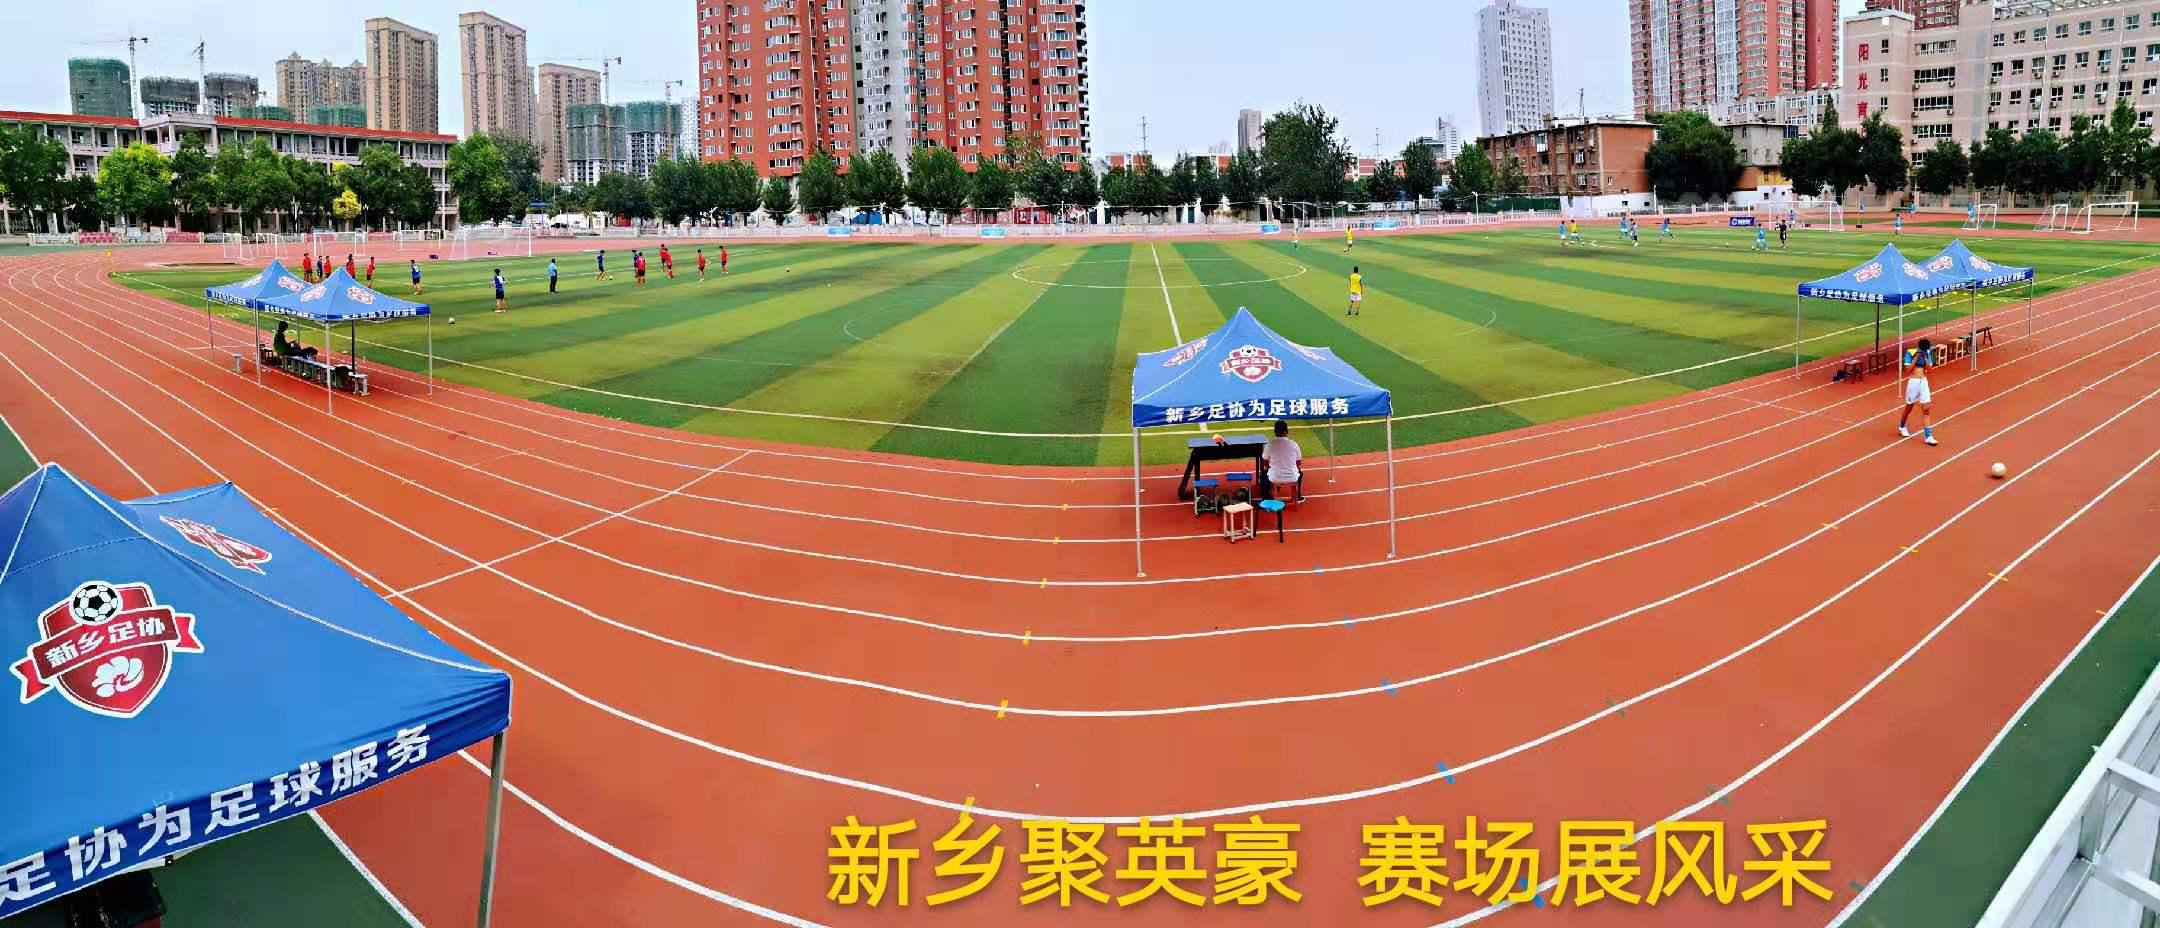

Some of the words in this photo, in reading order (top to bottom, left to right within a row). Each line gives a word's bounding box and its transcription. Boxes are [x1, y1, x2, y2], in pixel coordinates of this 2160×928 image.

[1857, 43, 1869, 137] 阳光育
[1165, 398, 1349, 423] 新乡足协为足球服务
[44, 617, 166, 668] 新乡足协
[0, 724, 431, 907] 足协为足球服务
